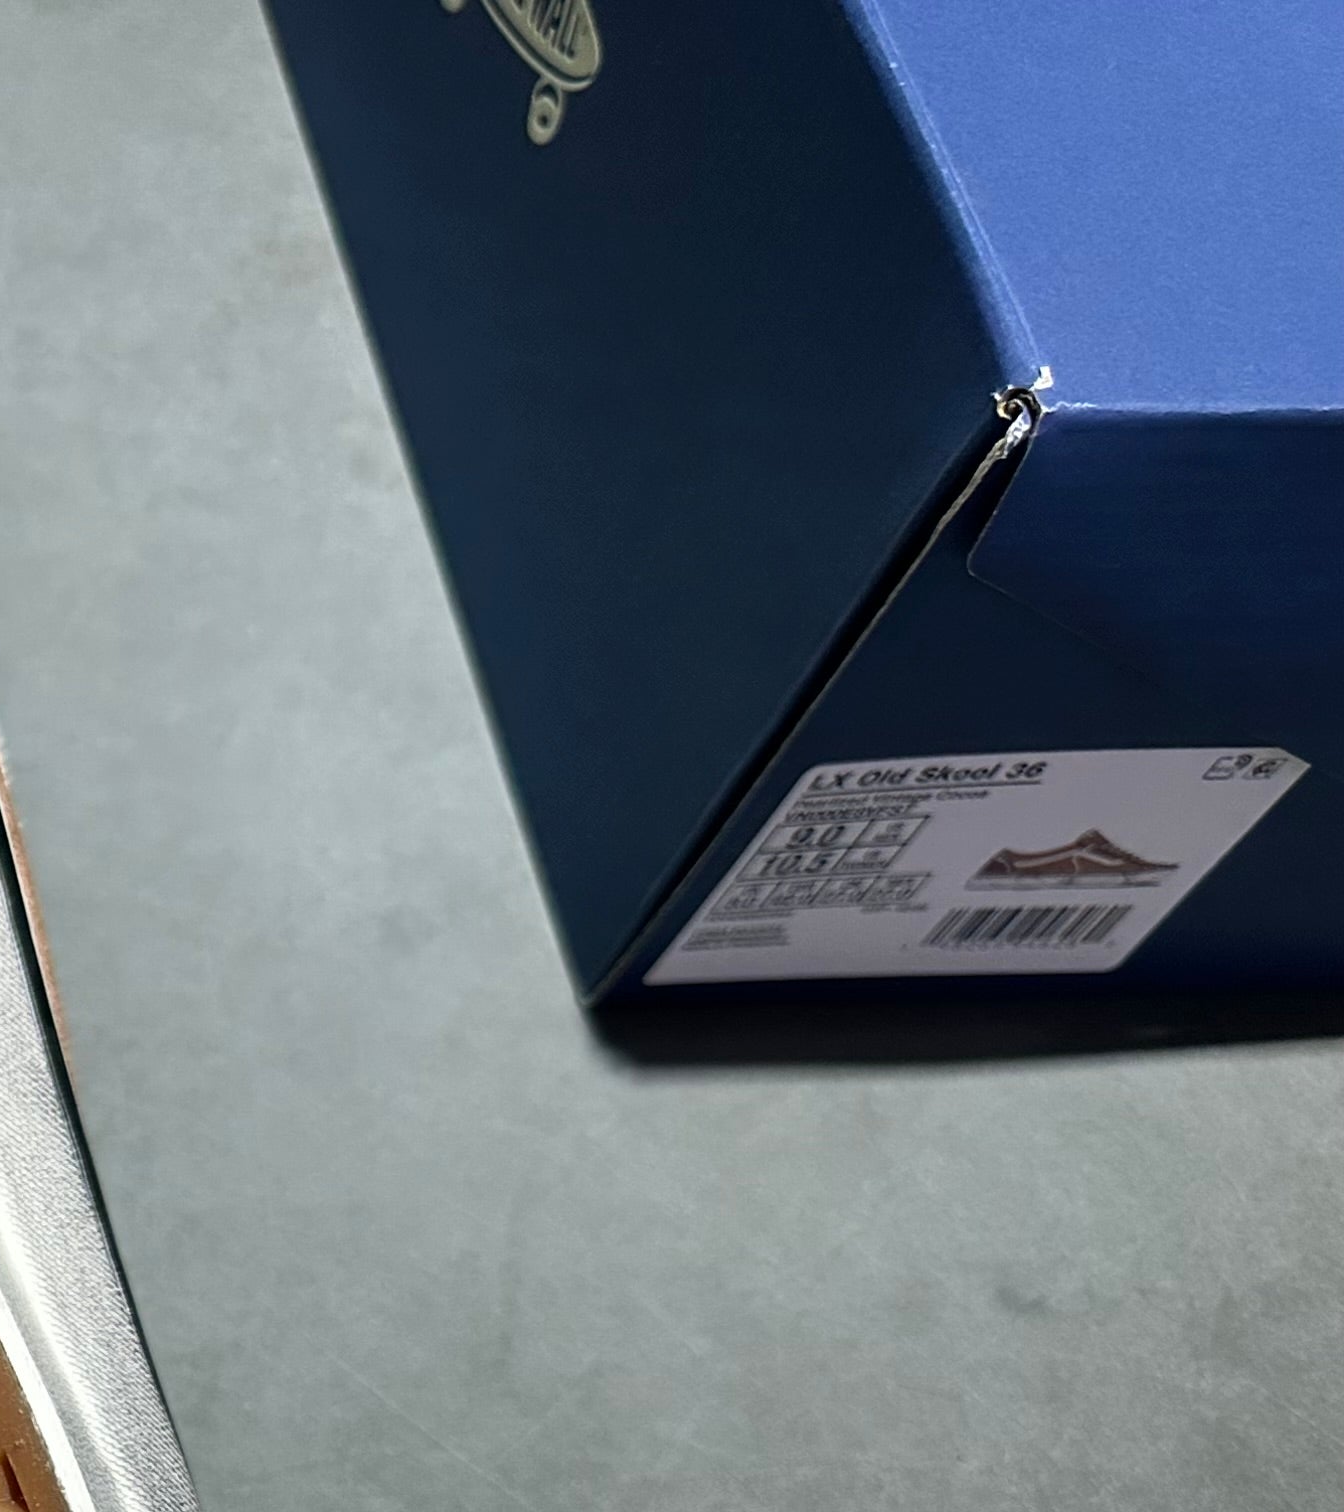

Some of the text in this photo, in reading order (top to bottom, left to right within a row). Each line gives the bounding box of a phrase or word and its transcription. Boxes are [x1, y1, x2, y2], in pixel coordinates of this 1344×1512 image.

[809, 761, 1047, 792] LX Old Skool 36
